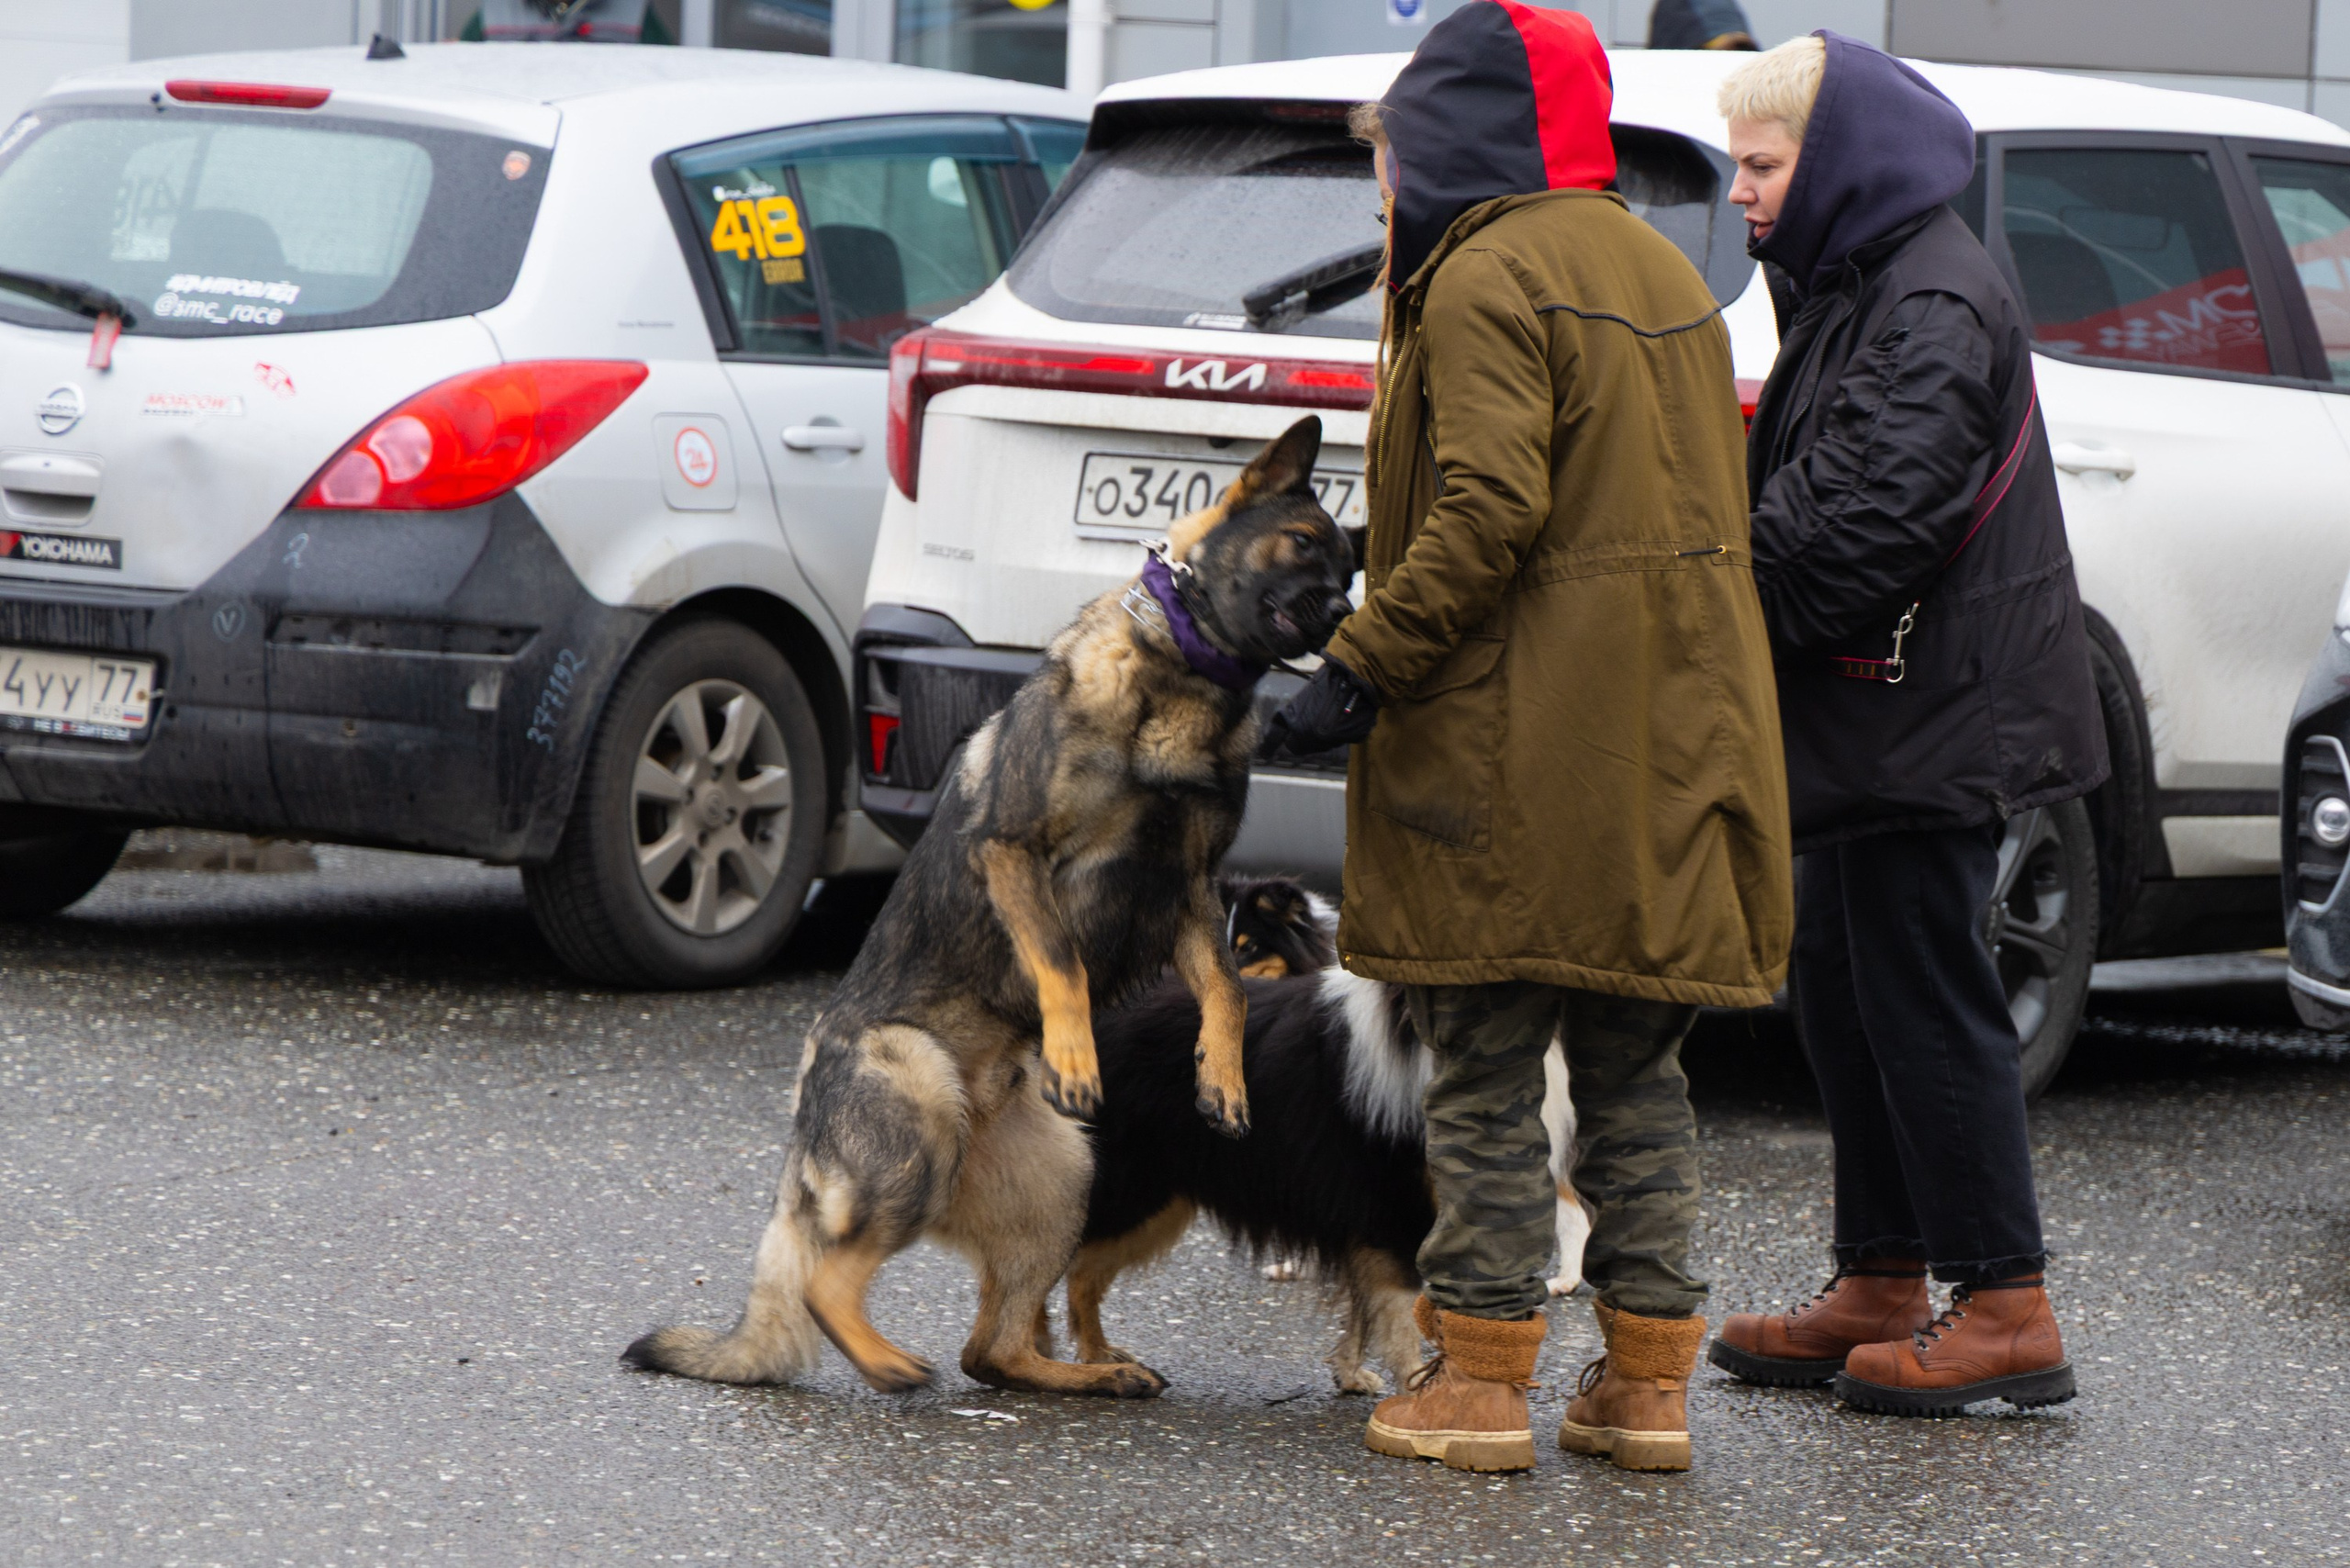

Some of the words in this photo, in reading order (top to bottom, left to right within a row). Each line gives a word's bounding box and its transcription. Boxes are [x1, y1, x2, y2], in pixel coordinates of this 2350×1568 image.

[711, 196, 806, 261] 418
[153, 292, 284, 325] @smc_race
[1165, 358, 1268, 391] KIA
[20, 534, 113, 565] YOKOHAMA
[98, 664, 138, 704] 77
